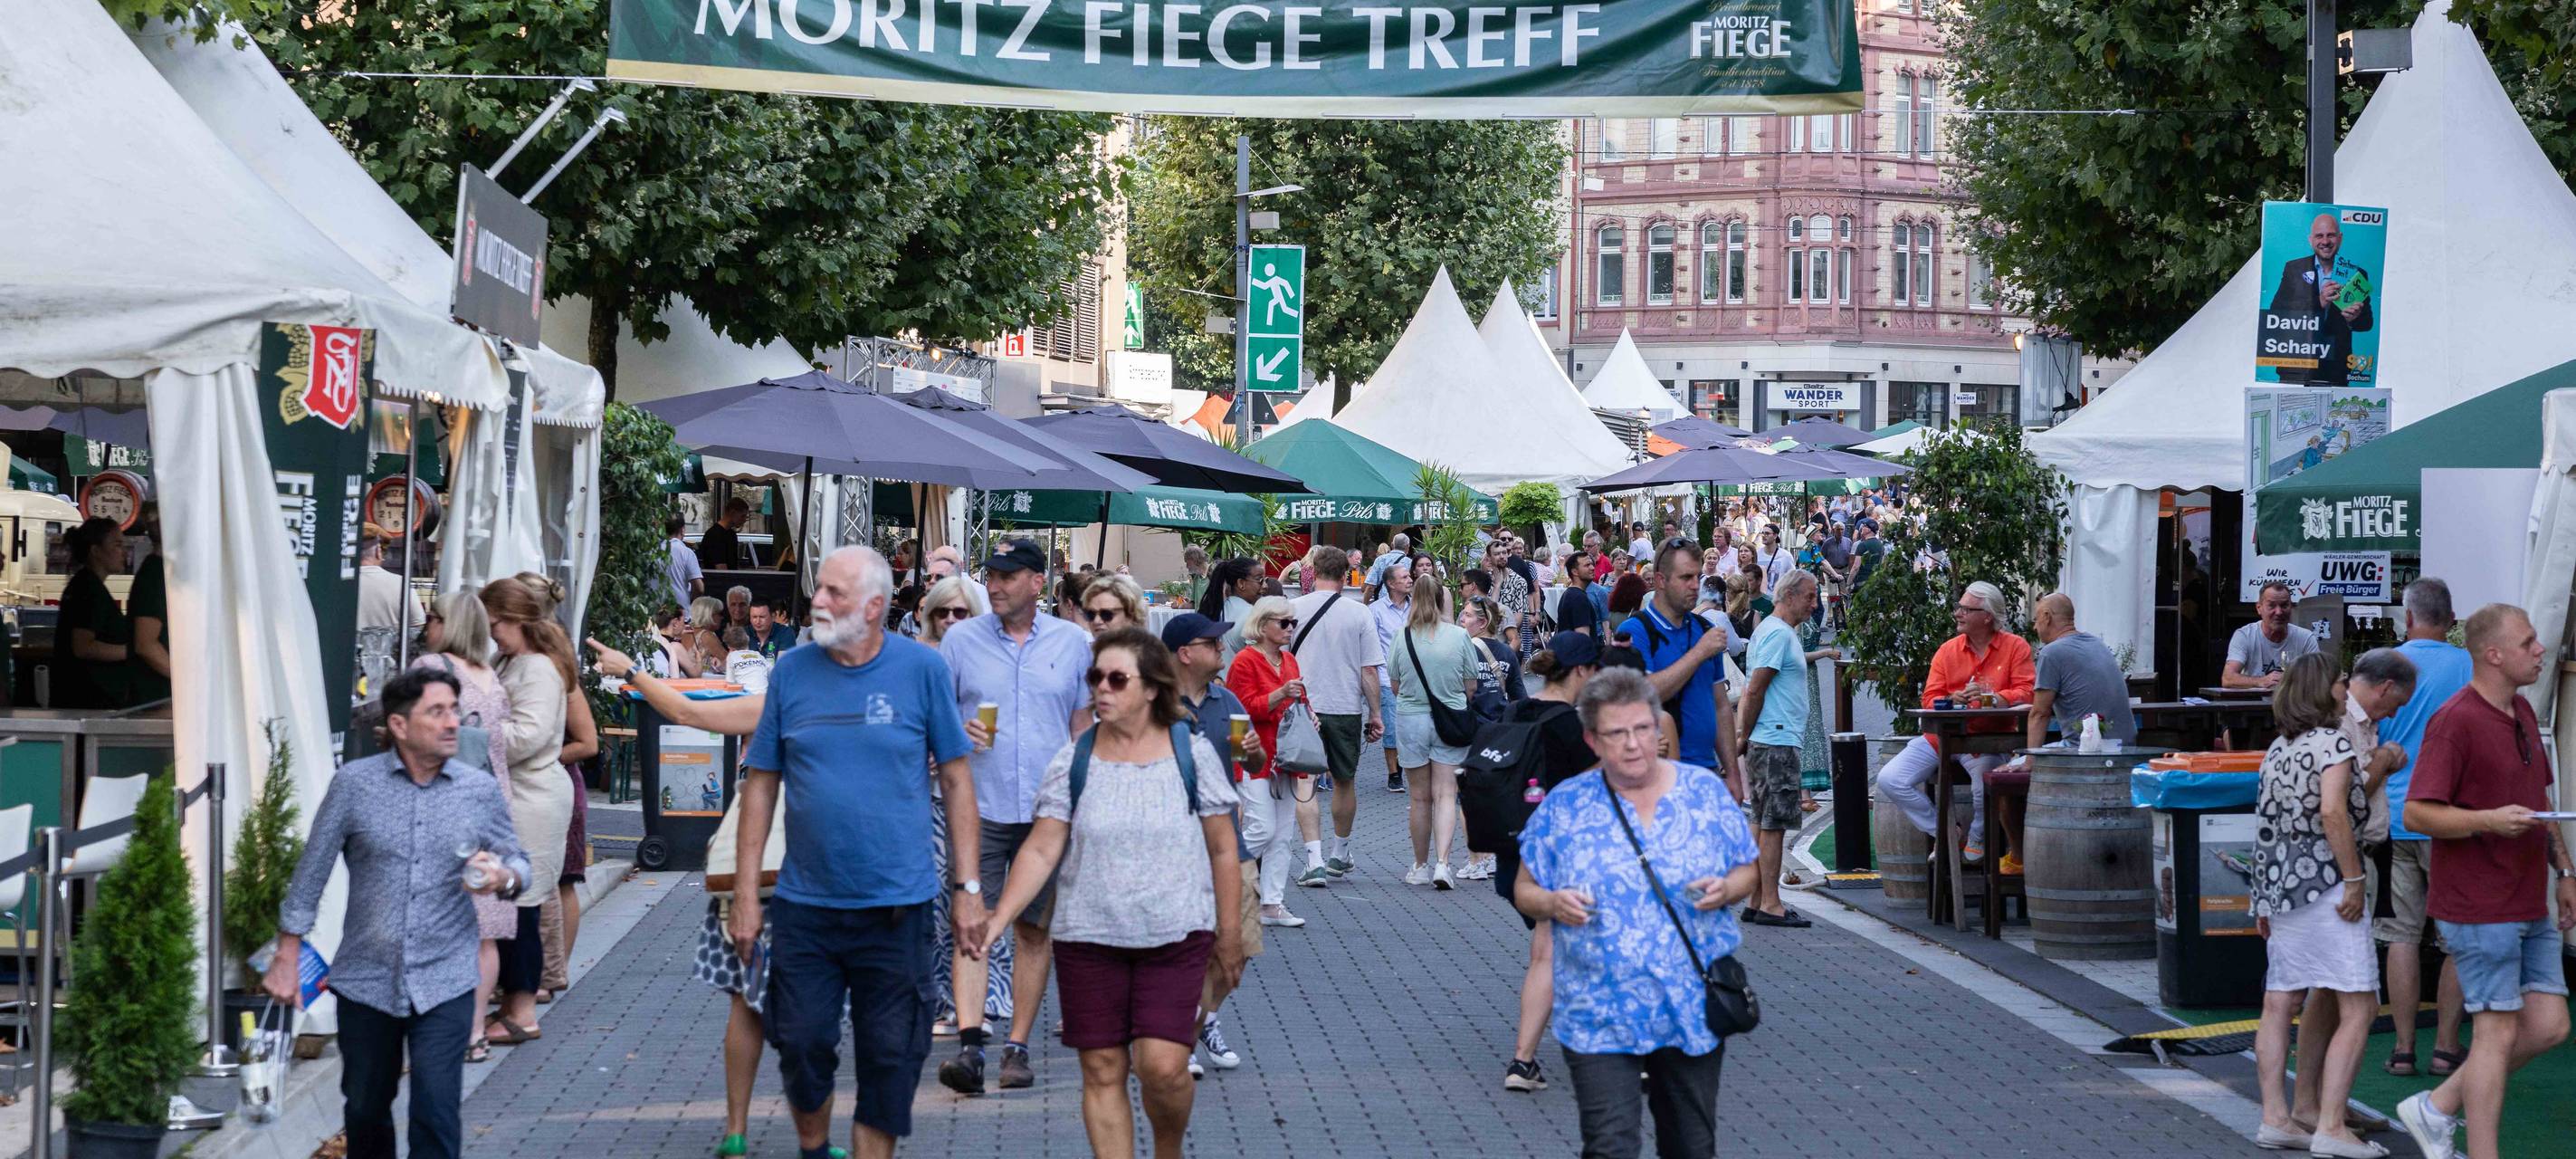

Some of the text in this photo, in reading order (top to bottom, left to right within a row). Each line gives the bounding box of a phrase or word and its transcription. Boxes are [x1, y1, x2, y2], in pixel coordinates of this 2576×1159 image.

[1713, 15, 1770, 29] MORITZ
[693, 0, 1600, 71] MORITZ FIEGE TREFF
[1690, 20, 1791, 59] FIEGE
[1741, 79, 1766, 88] 1878
[2352, 213, 2381, 224] CDU
[2266, 314, 2320, 331] David
[2265, 338, 2331, 359] Schary
[2346, 374, 2371, 382] Bochum
[1784, 389, 1844, 400] WANDER
[1750, 482, 1774, 493] FIEGE
[2353, 495, 2392, 509] MORITZ
[1159, 501, 1208, 522] FIEGE Pils
[1291, 501, 1375, 520] FIEGE Pils
[301, 496, 318, 556] MORITZ
[2335, 500, 2408, 538] FIEGE
[2266, 568, 2288, 578] WIR
[2320, 585, 2380, 596] Freie Bürger
[1480, 747, 1503, 763] bfs
